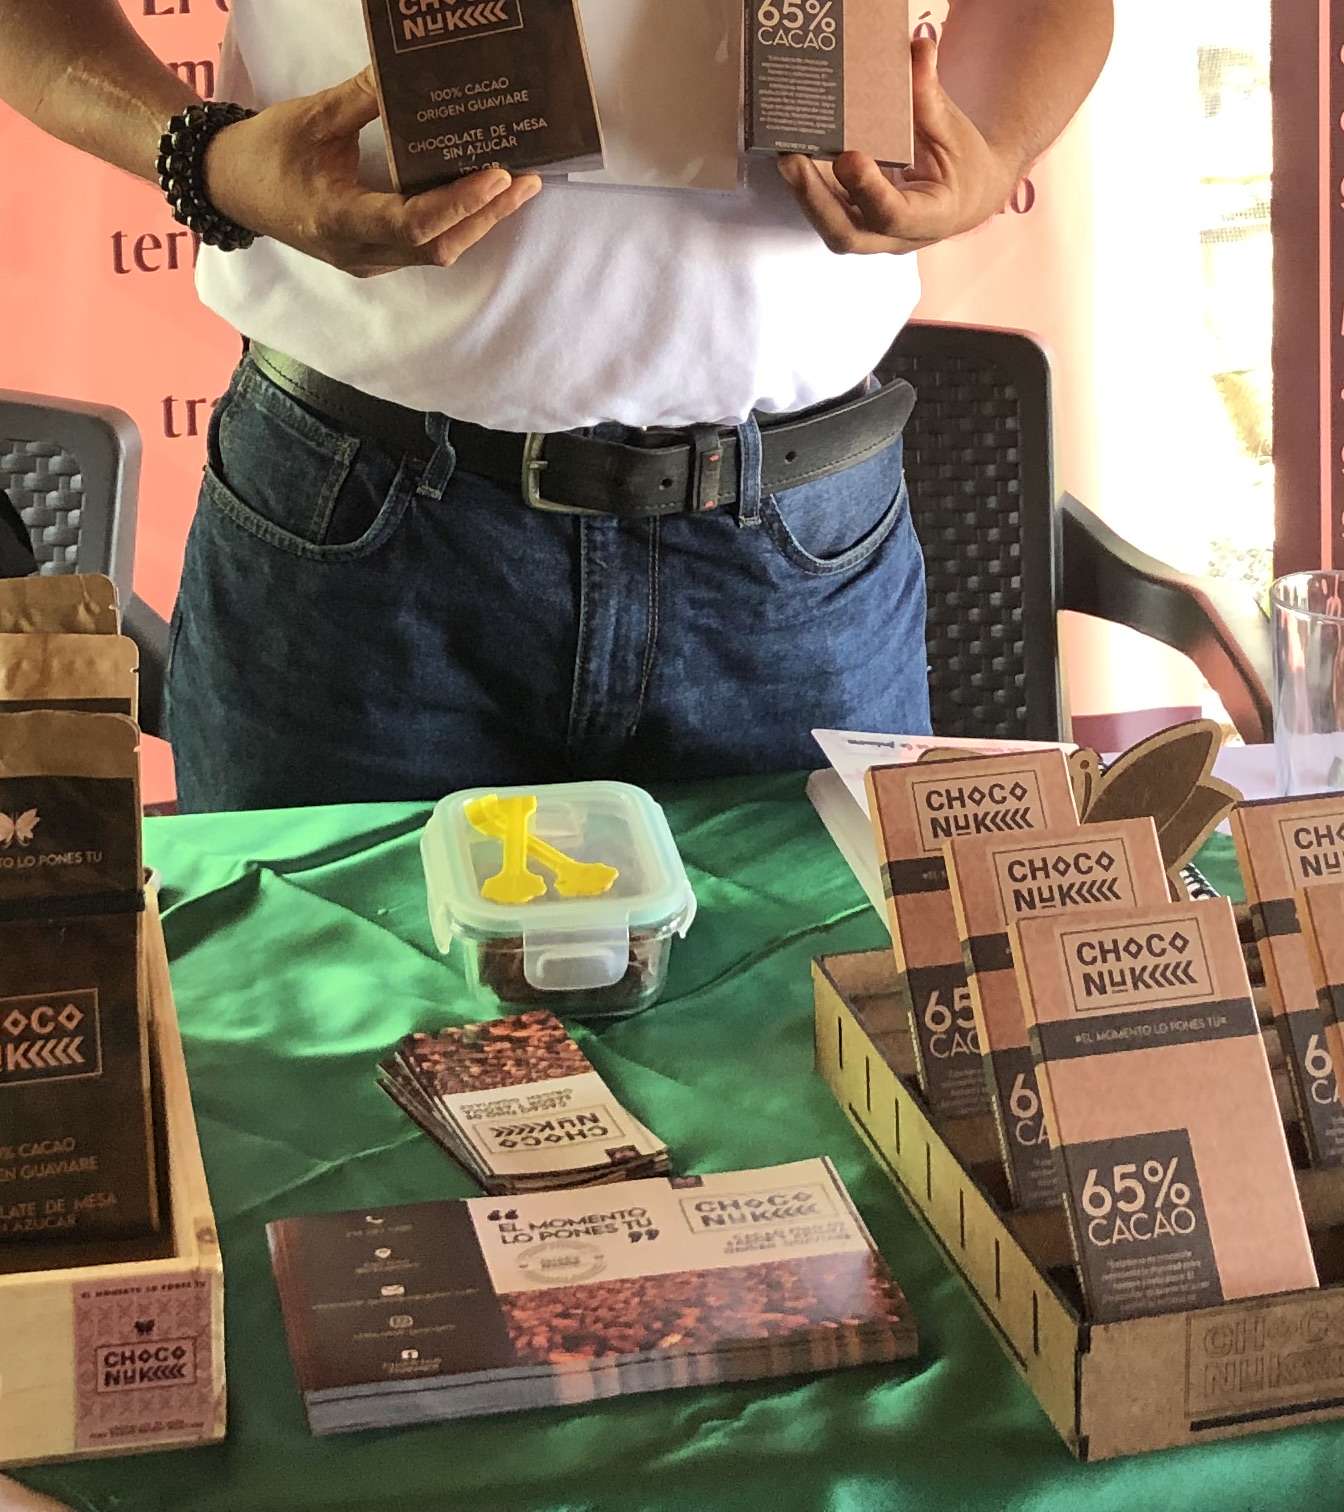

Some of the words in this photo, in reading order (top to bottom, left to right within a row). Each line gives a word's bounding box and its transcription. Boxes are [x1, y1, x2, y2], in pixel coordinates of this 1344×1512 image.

[758, 27, 836, 51] CACAO
[430, 87, 462, 102] 100%
[465, 77, 509, 95] CACAO
[417, 103, 464, 122] ORIGEN
[468, 90, 529, 111] GUAVIARE
[408, 129, 484, 153] CHOCOLATE
[490, 125, 506, 137] DE
[513, 118, 548, 132] MESA
[443, 146, 463, 160] SIN
[467, 136, 518, 155] AZUCAR
[925, 781, 1028, 812] CHOCO
[1007, 850, 1115, 883] CHOCO
[1076, 931, 1190, 967] CHOCO
[1081, 1157, 1191, 1217] 65%
[695, 1191, 814, 1214] CHOCO
[529, 1206, 648, 1231] MOMENTO
[1087, 1207, 1196, 1248] CACAO
[500, 1231, 534, 1245] LO
[539, 1224, 619, 1242] PONES
[104, 1345, 187, 1368] CHOCO
